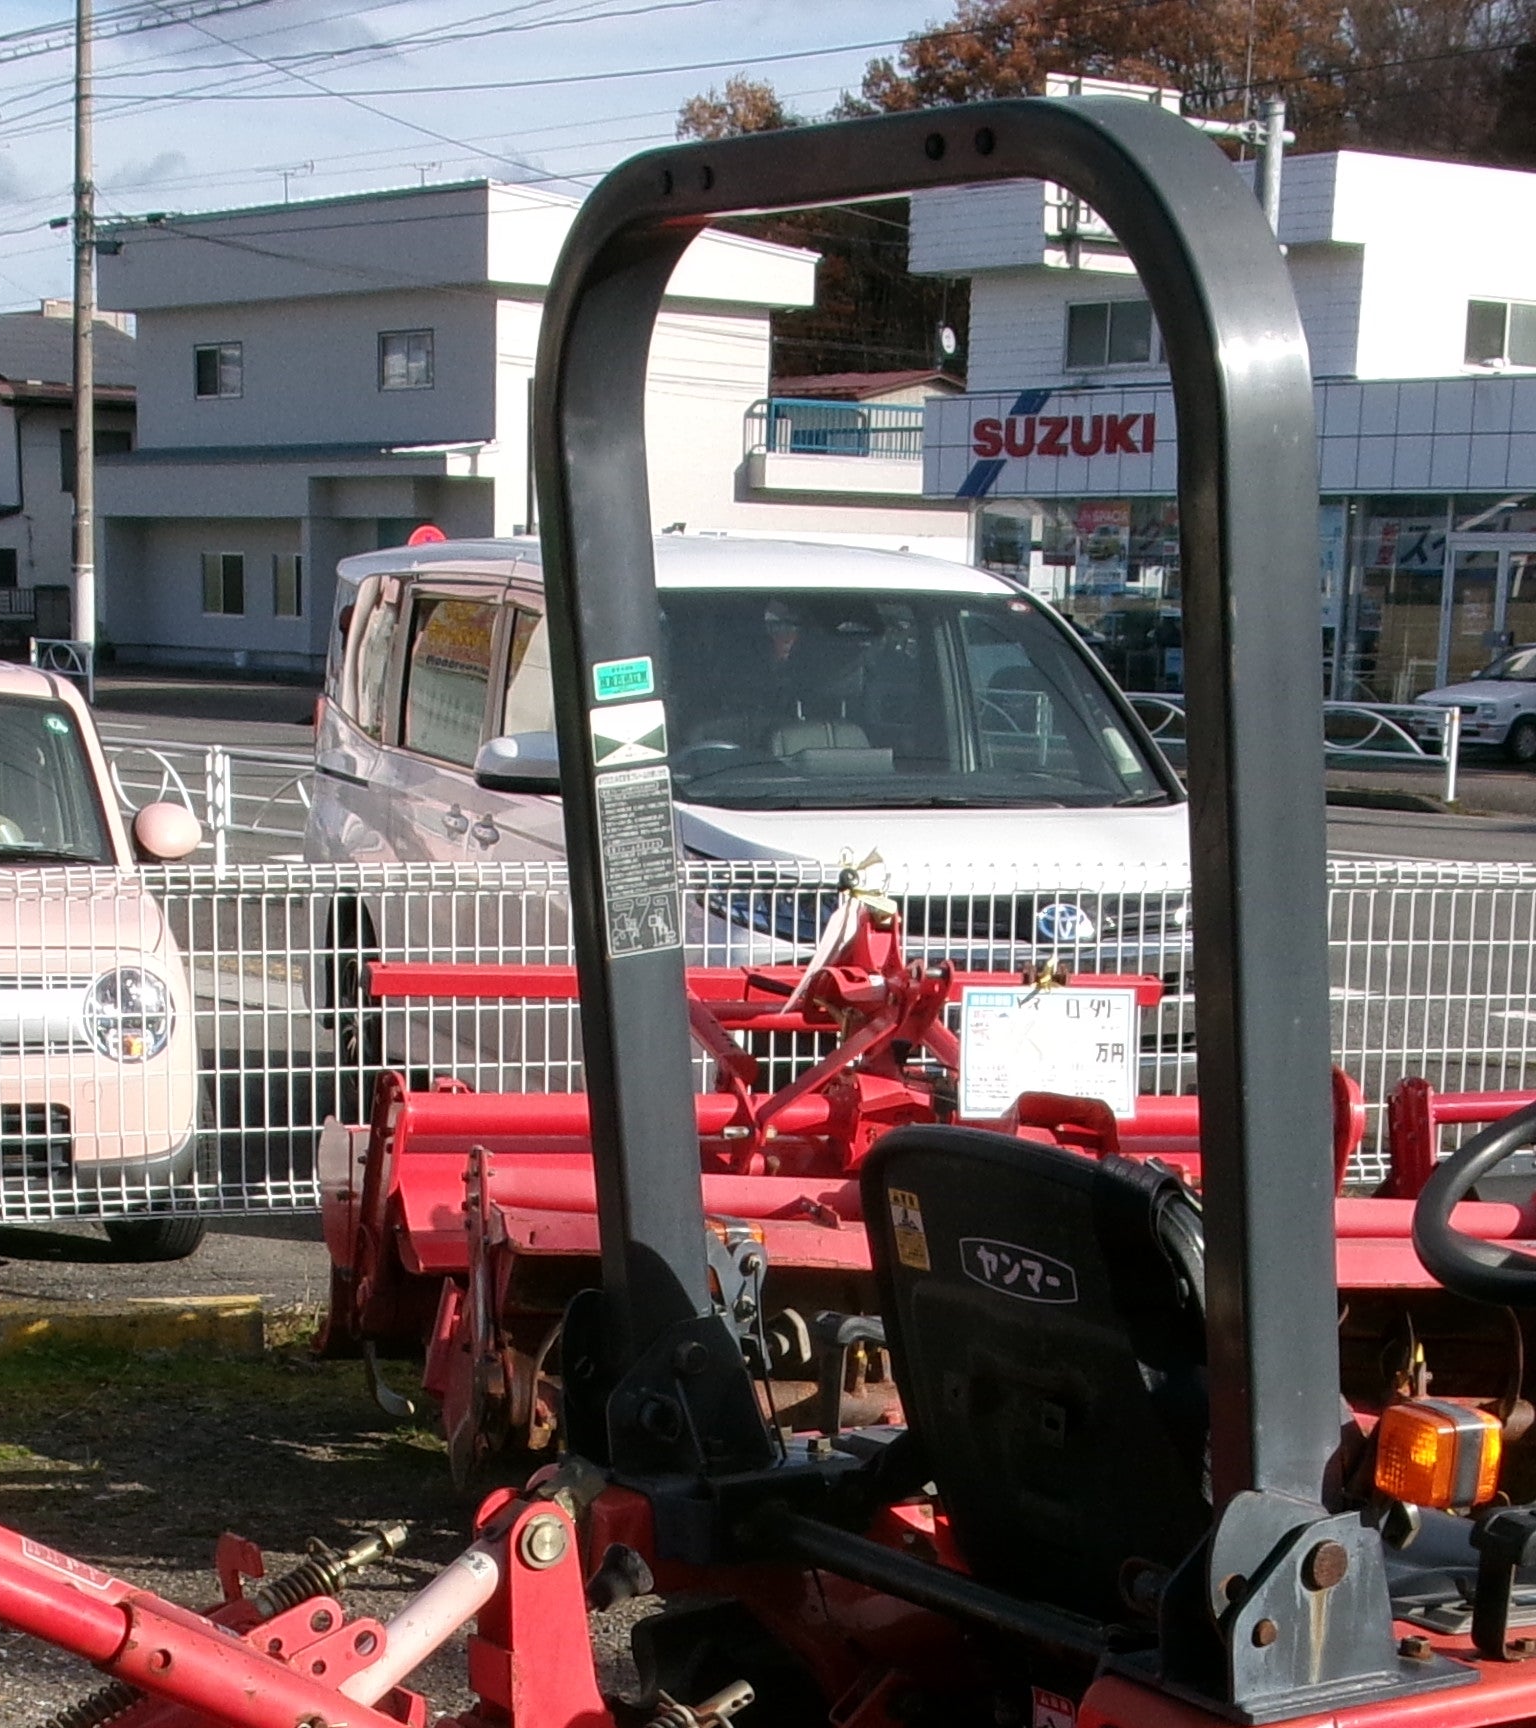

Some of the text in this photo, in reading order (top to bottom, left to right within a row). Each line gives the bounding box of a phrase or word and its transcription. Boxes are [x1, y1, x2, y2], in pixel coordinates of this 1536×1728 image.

[972, 411, 1156, 458] SUZUKI
[1095, 1042, 1125, 1063] 万円
[976, 1244, 1061, 1294] ヤンマー
